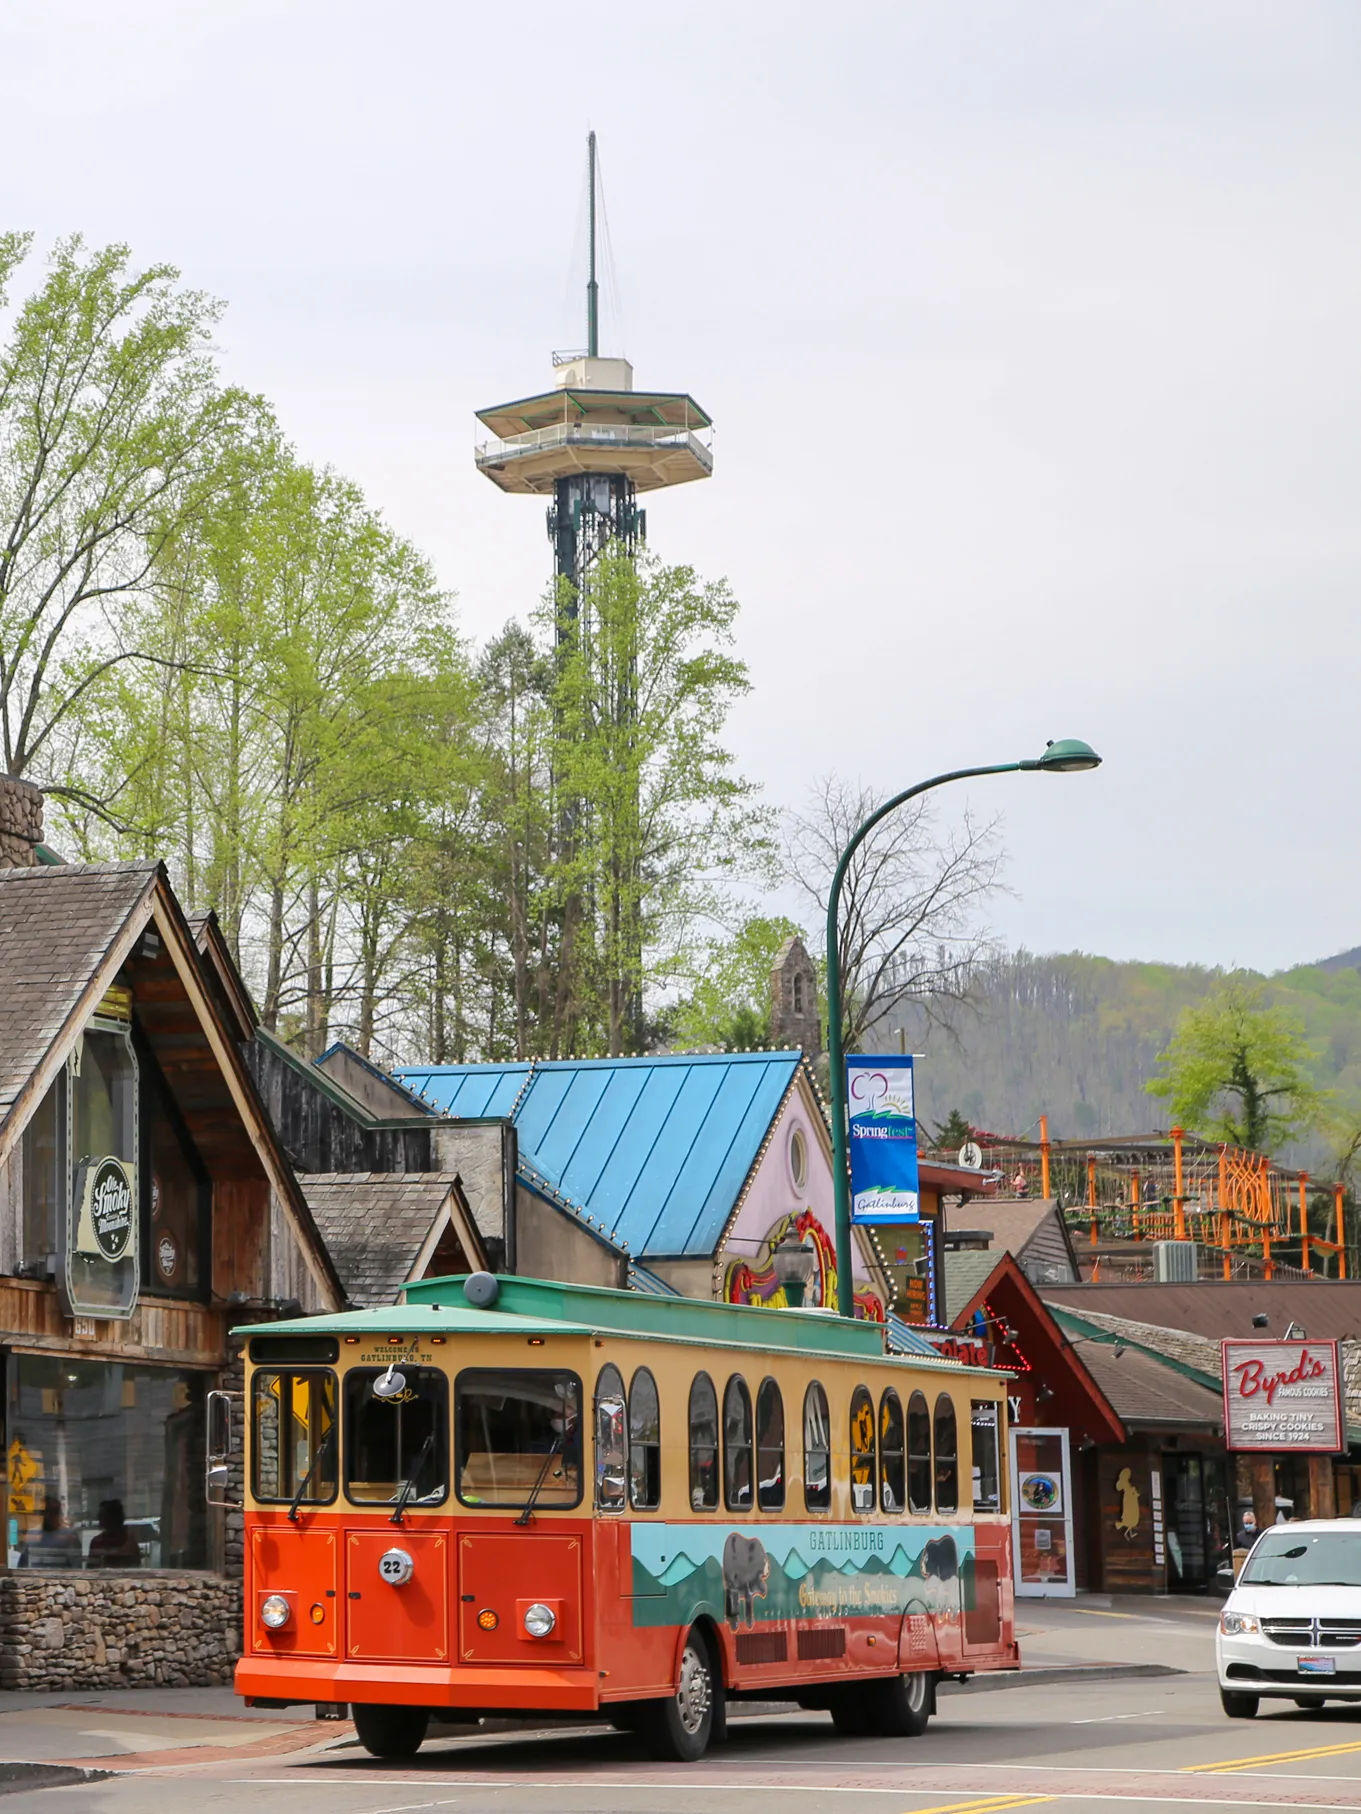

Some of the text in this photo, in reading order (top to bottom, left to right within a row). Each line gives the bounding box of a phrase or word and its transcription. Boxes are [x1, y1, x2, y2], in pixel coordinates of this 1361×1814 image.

[93, 1182, 130, 1217] Smoky
[857, 1197, 915, 1211] Gatlinburg
[930, 1338, 989, 1367] olate
[1233, 1349, 1326, 1406] Byrd's
[1278, 1387, 1328, 1397] FAMOUS COOKIES
[1250, 1413, 1314, 1421] BAKING TINY
[1241, 1422, 1324, 1431] CRISPY COOKIES
[1256, 1432, 1309, 1440] SINCE 1924
[809, 1531, 884, 1551] GATLINBURG
[384, 1561, 400, 1573] 22
[798, 1581, 897, 1612] Gateway to the Smokies
